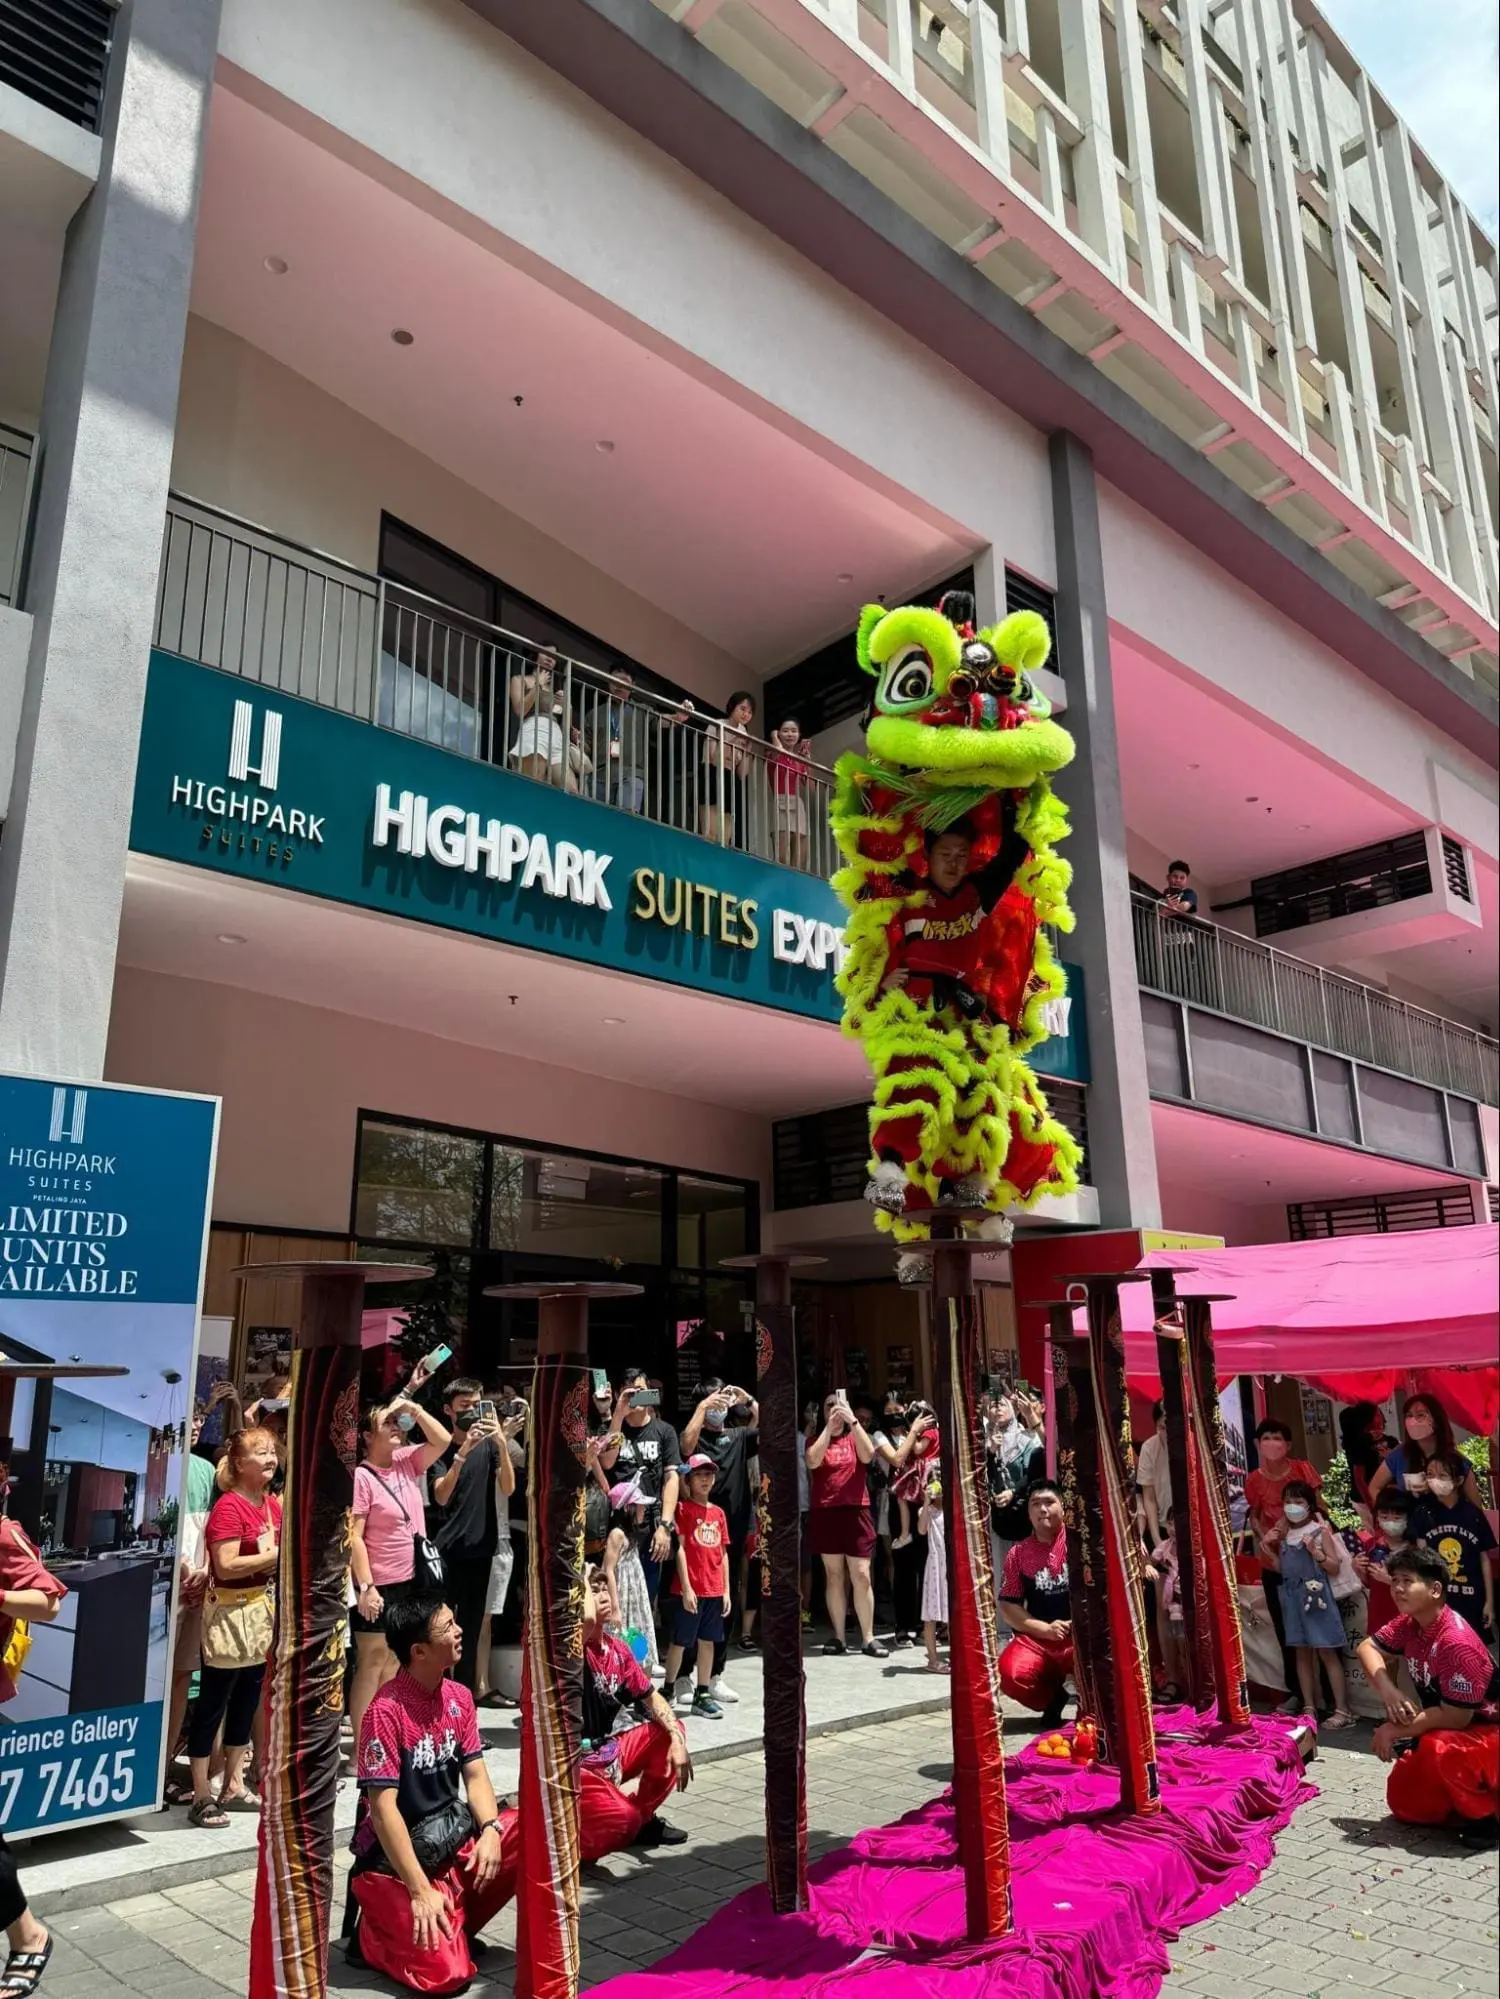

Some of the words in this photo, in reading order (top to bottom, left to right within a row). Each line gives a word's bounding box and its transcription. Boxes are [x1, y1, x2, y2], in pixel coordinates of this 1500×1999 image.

[171, 775, 326, 844] HIGHPARK
[202, 824, 294, 862] SUITES
[372, 783, 614, 911] HIGHPARK
[634, 866, 760, 950] SUITES
[9, 1147, 117, 1175] HIGHPARK
[27, 1175, 93, 1192] SUITES
[3, 1236, 107, 1267] UNITS
[0, 1265, 139, 1295] AILABLE
[71, 1715, 139, 1745] Gallery
[37, 1748, 136, 1818] 7465
